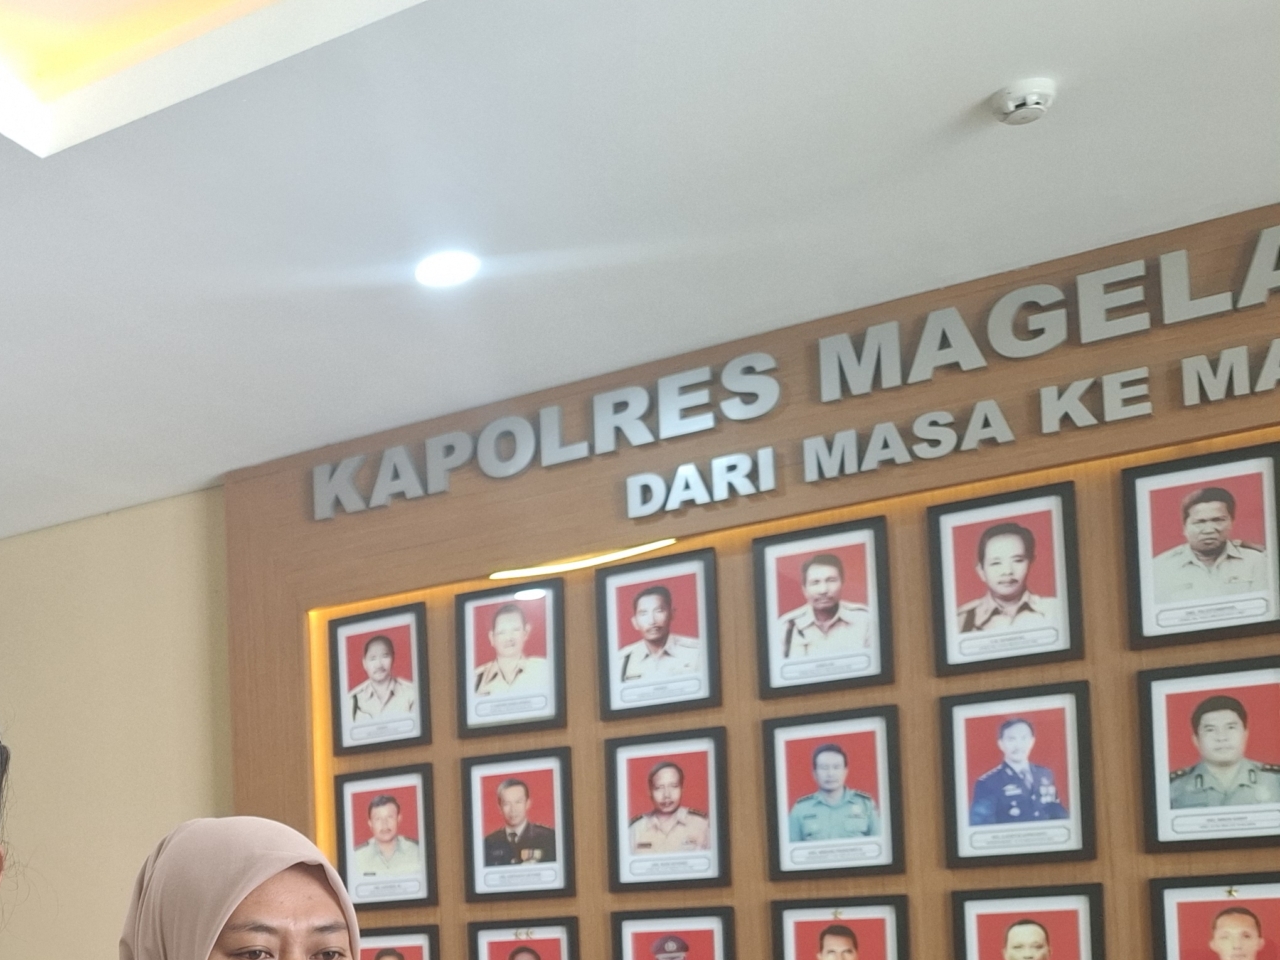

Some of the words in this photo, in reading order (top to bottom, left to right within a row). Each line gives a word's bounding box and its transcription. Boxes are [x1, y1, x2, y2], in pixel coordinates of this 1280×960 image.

[313, 353, 781, 520] KAPOLRES
[625, 447, 776, 519] DARI
[802, 398, 1016, 484] MASA
[1040, 366, 1152, 434] KE
